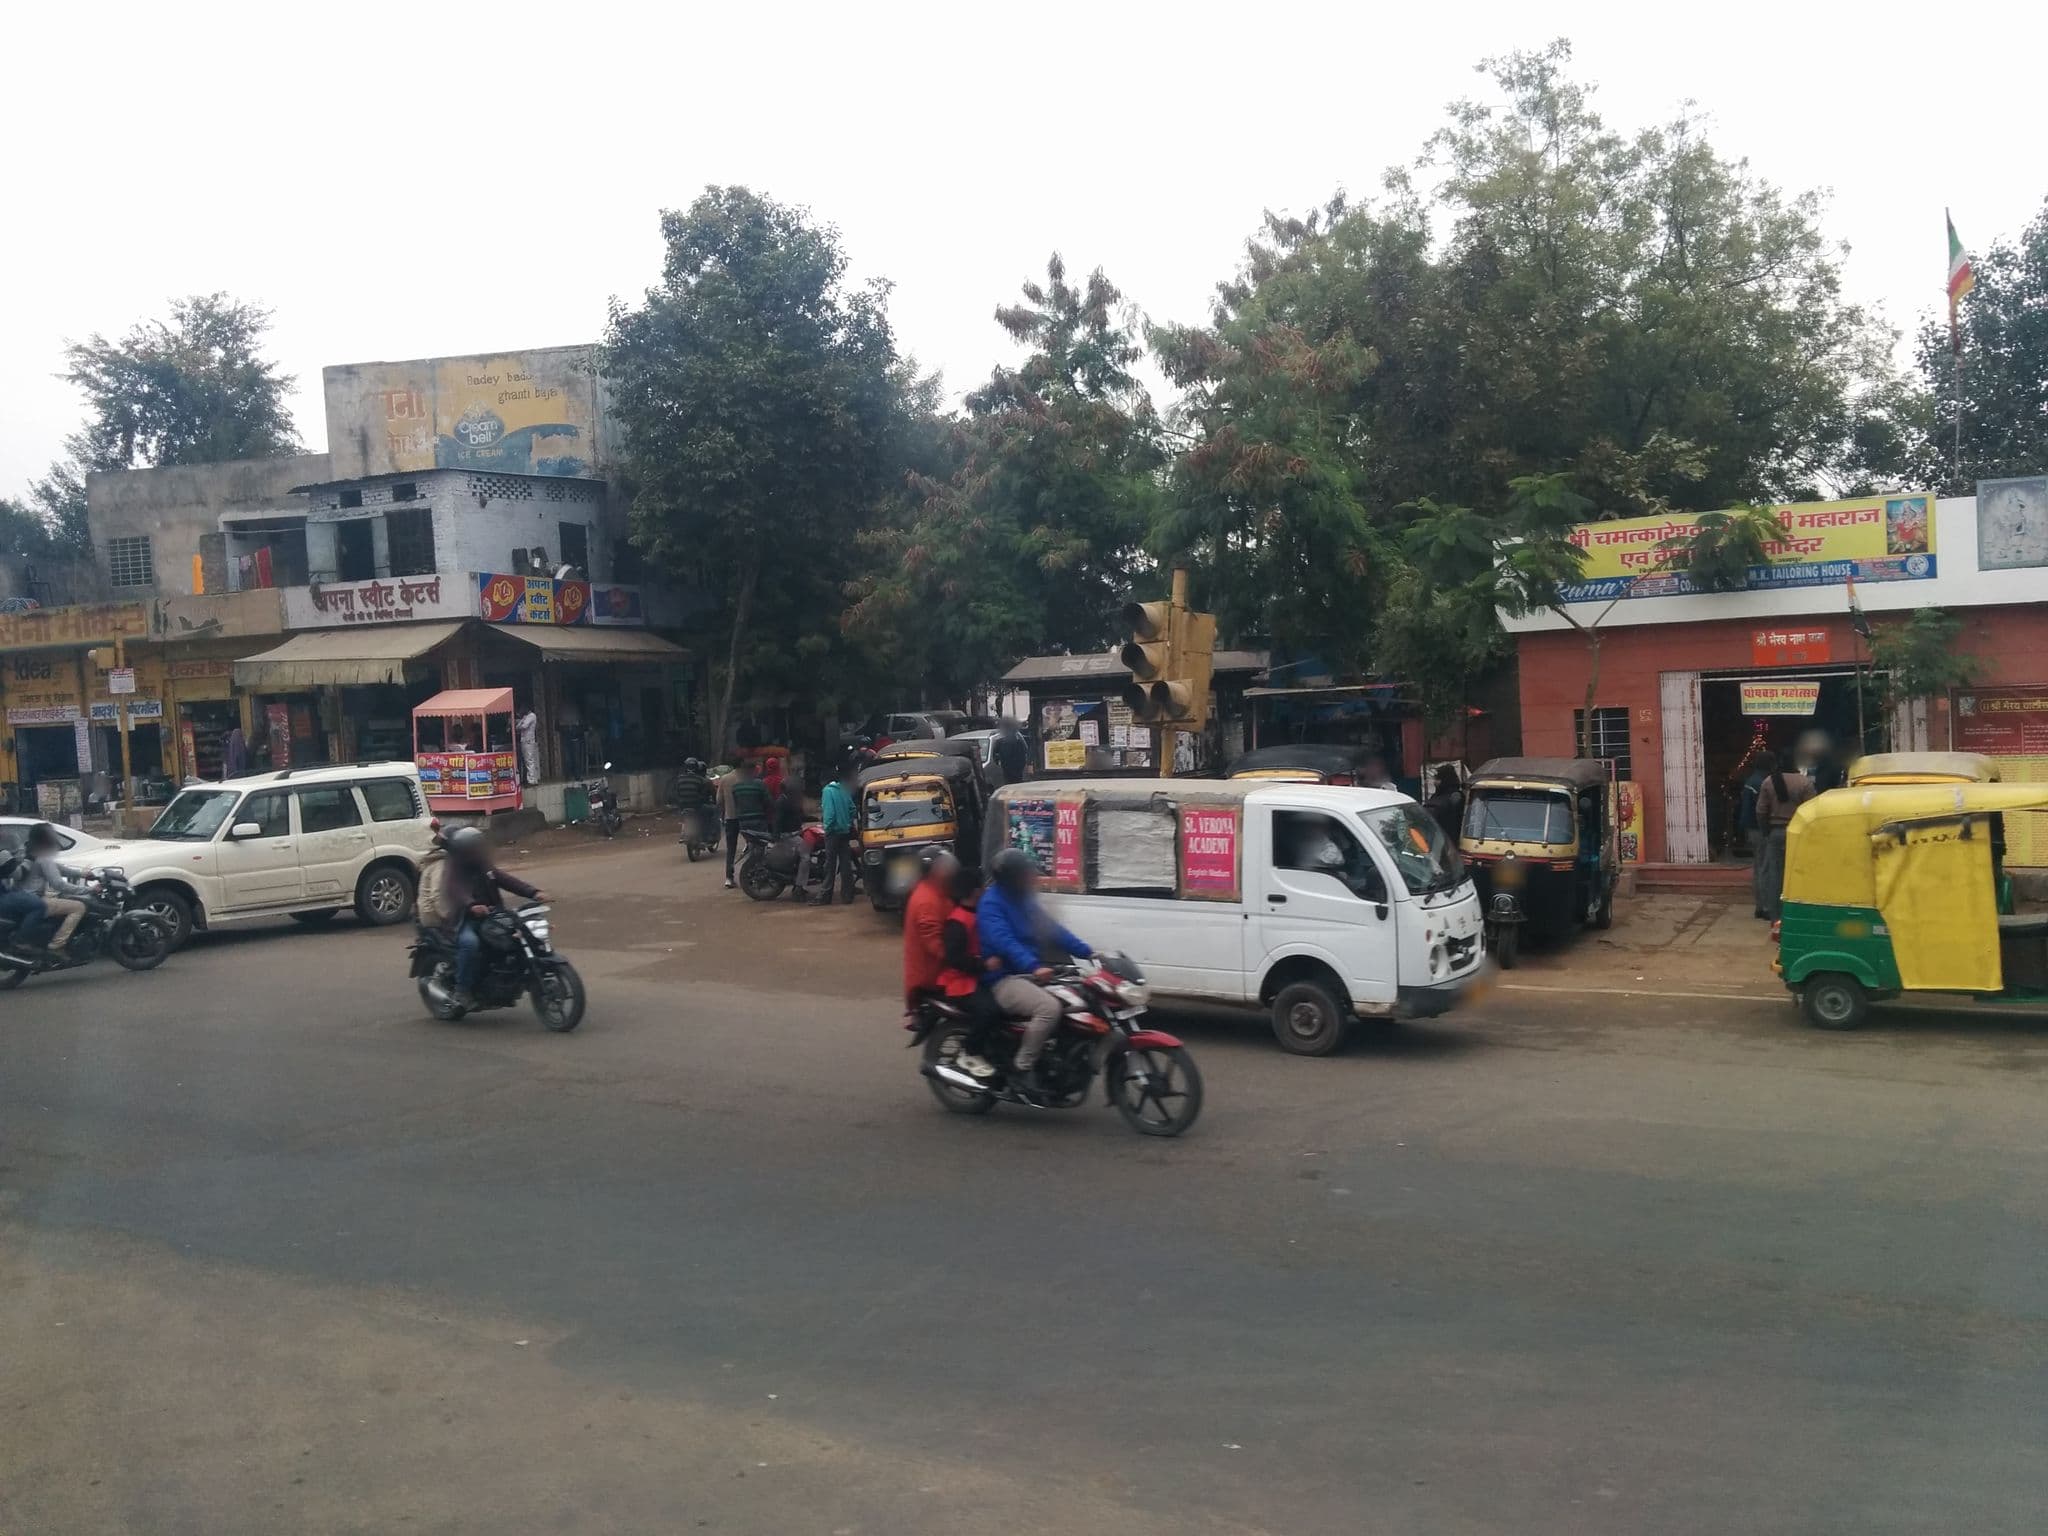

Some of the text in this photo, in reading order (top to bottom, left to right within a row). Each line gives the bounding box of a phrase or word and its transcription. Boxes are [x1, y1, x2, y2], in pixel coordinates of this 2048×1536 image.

[459, 418, 498, 434] Cream
[469, 433, 492, 445] bell
[458, 449, 503, 459] ICE CREAM
[1798, 508, 1881, 528] महाराज
[1771, 565, 1818, 579] TAILORING
[1821, 564, 1852, 576] HOUSE
[527, 579, 550, 590] अपना
[312, 576, 441, 612] अपना स्वीट केटर्स
[1199, 817, 1235, 834] VERONA
[1187, 837, 1230, 854] ACADEMY
[1187, 868, 1209, 879] English
